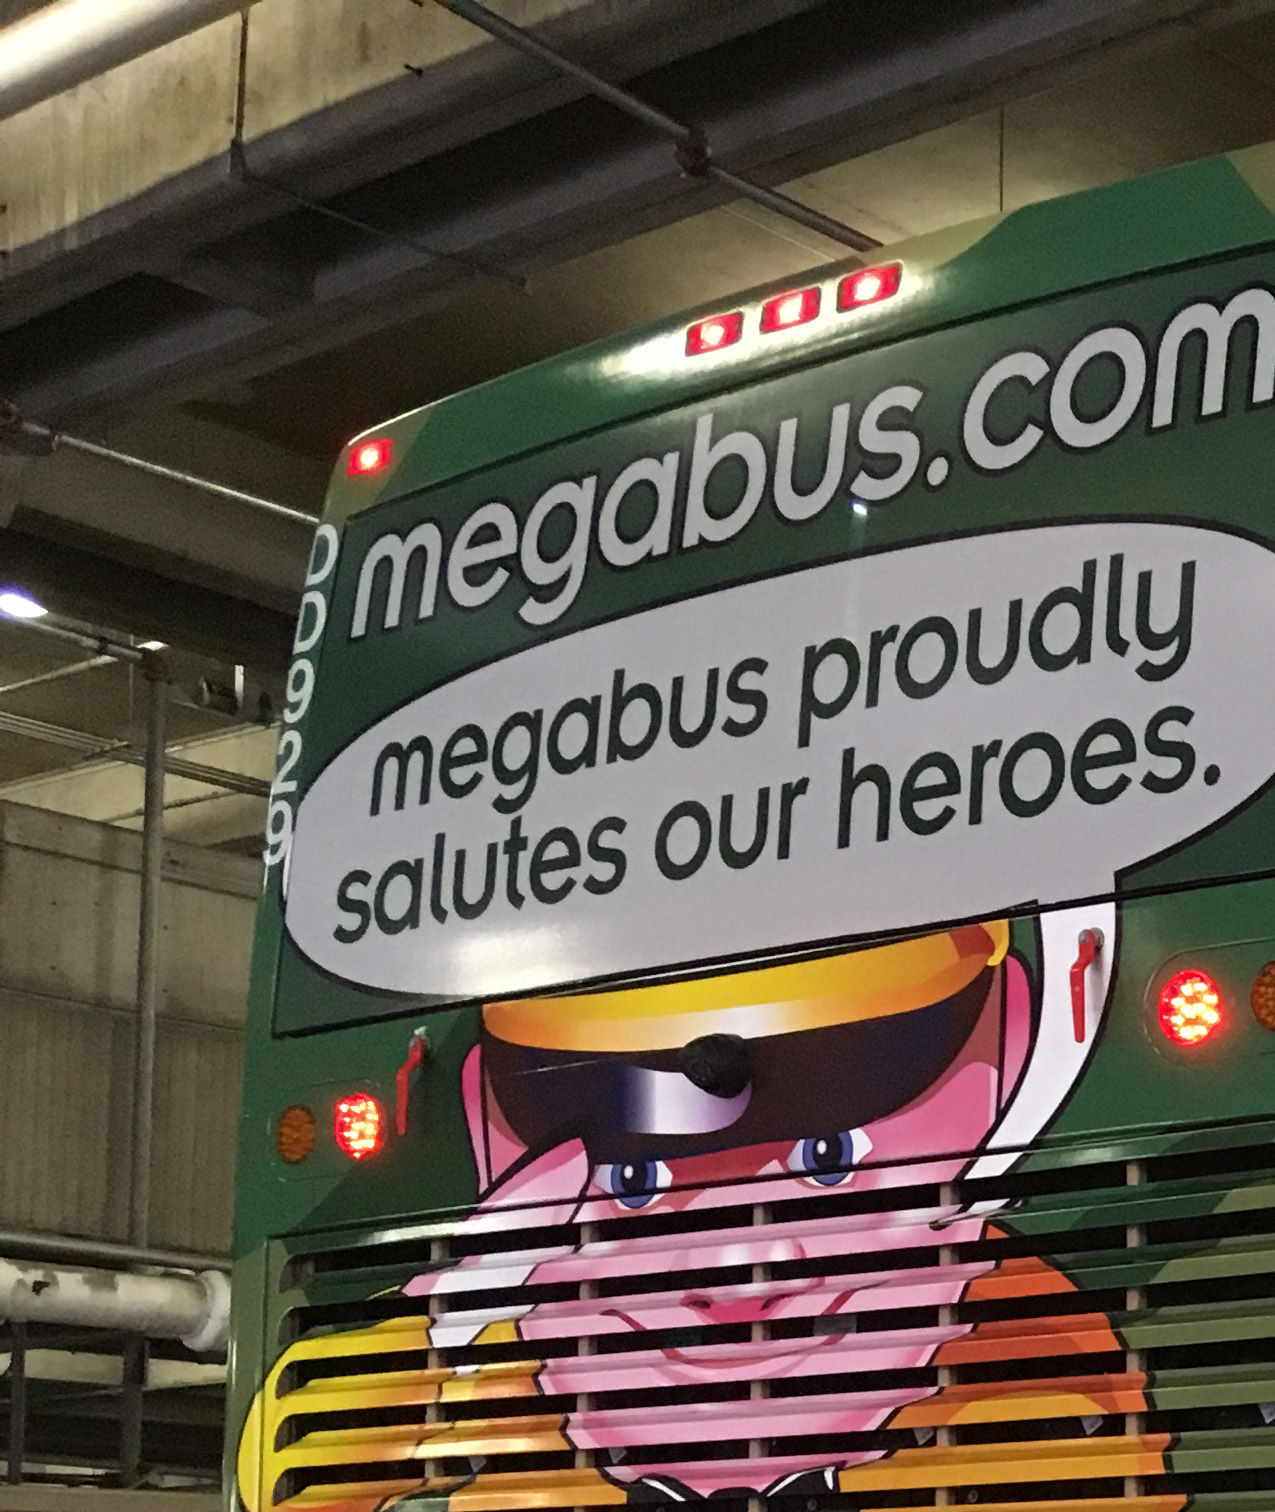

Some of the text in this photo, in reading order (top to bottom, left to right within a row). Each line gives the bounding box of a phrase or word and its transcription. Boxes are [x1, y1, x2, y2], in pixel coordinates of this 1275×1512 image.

[264, 523, 339, 866] DD929
[370, 551, 1196, 817] megabus proudly
[333, 704, 1221, 944] salutes our heroes.
